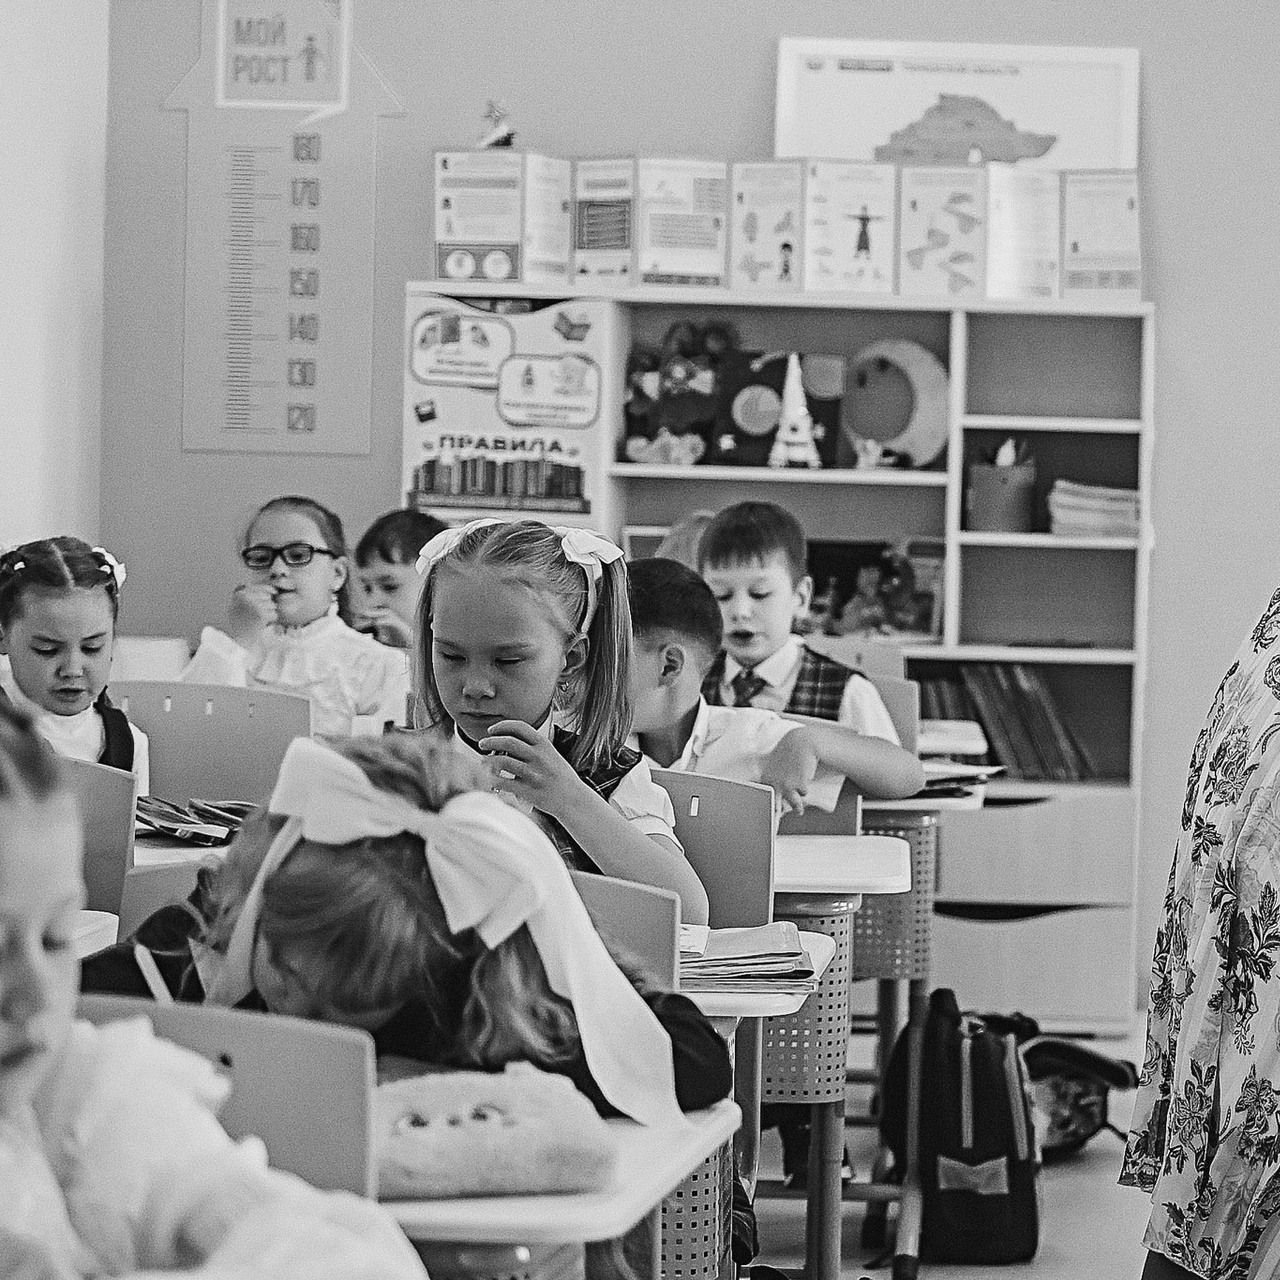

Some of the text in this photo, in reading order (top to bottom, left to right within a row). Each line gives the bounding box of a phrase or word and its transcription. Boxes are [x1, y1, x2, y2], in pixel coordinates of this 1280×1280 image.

[233, 12, 287, 46] МОЙ
[232, 55, 290, 84] РОСТ
[439, 434, 563, 453] ПРАВИЛА
